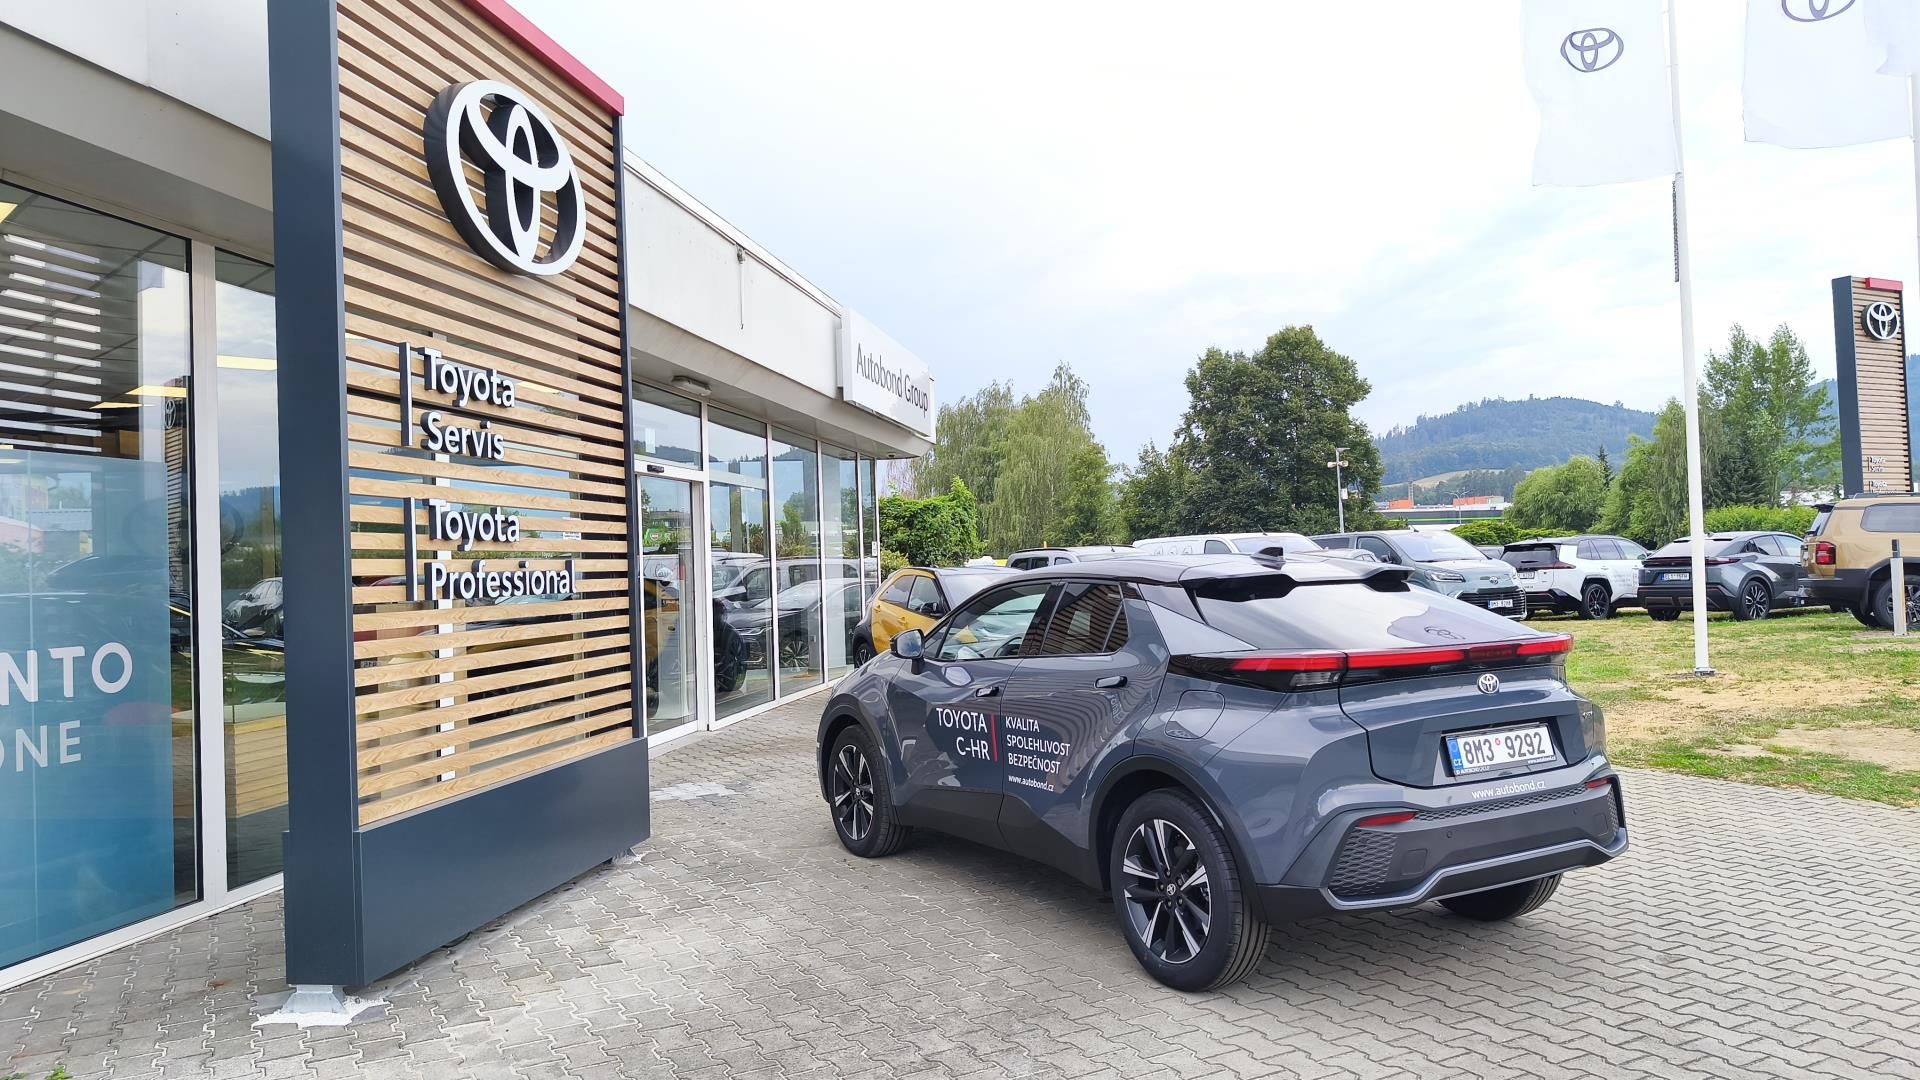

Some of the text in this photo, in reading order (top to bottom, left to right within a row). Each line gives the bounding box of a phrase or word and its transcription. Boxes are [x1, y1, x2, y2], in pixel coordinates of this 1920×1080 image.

[421, 347, 516, 408] Toyota
[856, 342, 929, 419] Autobond Group
[422, 411, 506, 460] Servis
[425, 498, 521, 552] Toyota
[426, 559, 577, 600] Professional
[936, 707, 988, 733] TOYOTA
[1005, 716, 1040, 733] KVALITA
[0, 720, 82, 773] NE
[956, 736, 990, 761] C-HR
[1006, 735, 1071, 757] SPOLEHLIVOST
[1463, 731, 1546, 765] 8M3 9292
[1008, 752, 1061, 775] BEZPEČNOST
[1453, 758, 1463, 767] CZ
[1008, 775, 1055, 792] www.autobond.cz
[1472, 779, 1546, 799] www.autobond.cz
